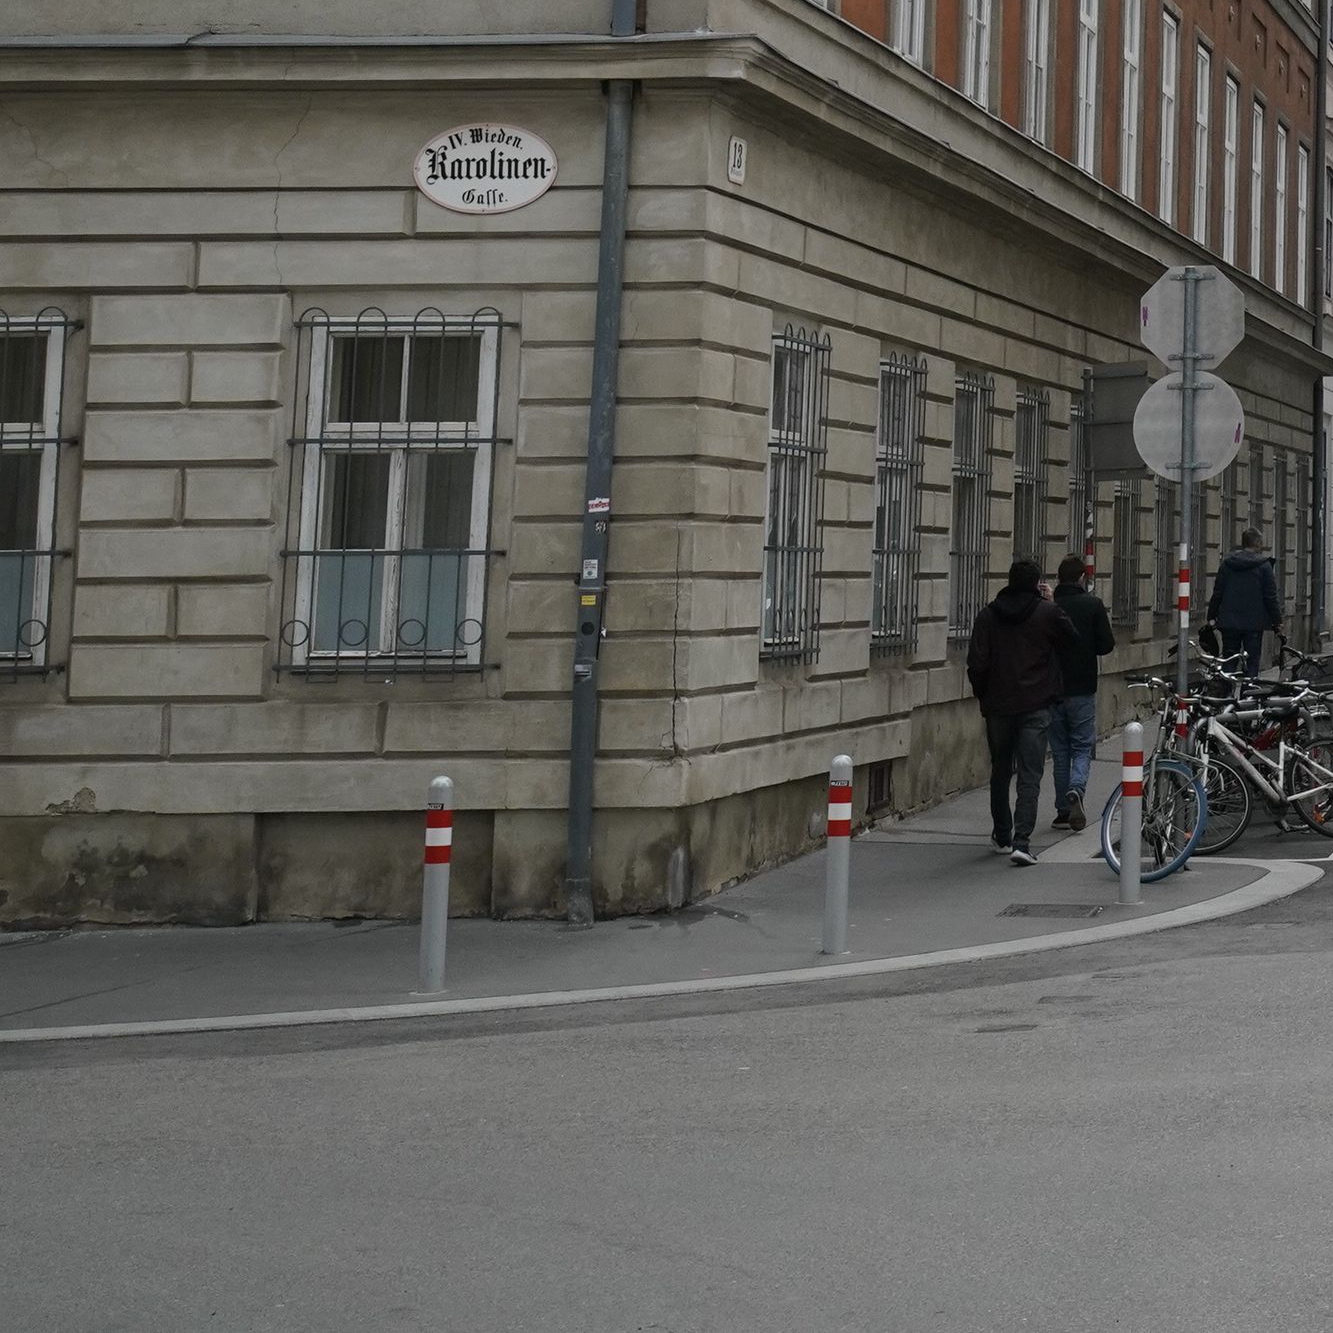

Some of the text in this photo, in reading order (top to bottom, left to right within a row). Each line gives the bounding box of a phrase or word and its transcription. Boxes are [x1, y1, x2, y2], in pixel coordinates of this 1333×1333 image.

[448, 127, 523, 150] IV. Wieden.
[425, 144, 551, 185] Karolinen-
[733, 142, 743, 169] 13
